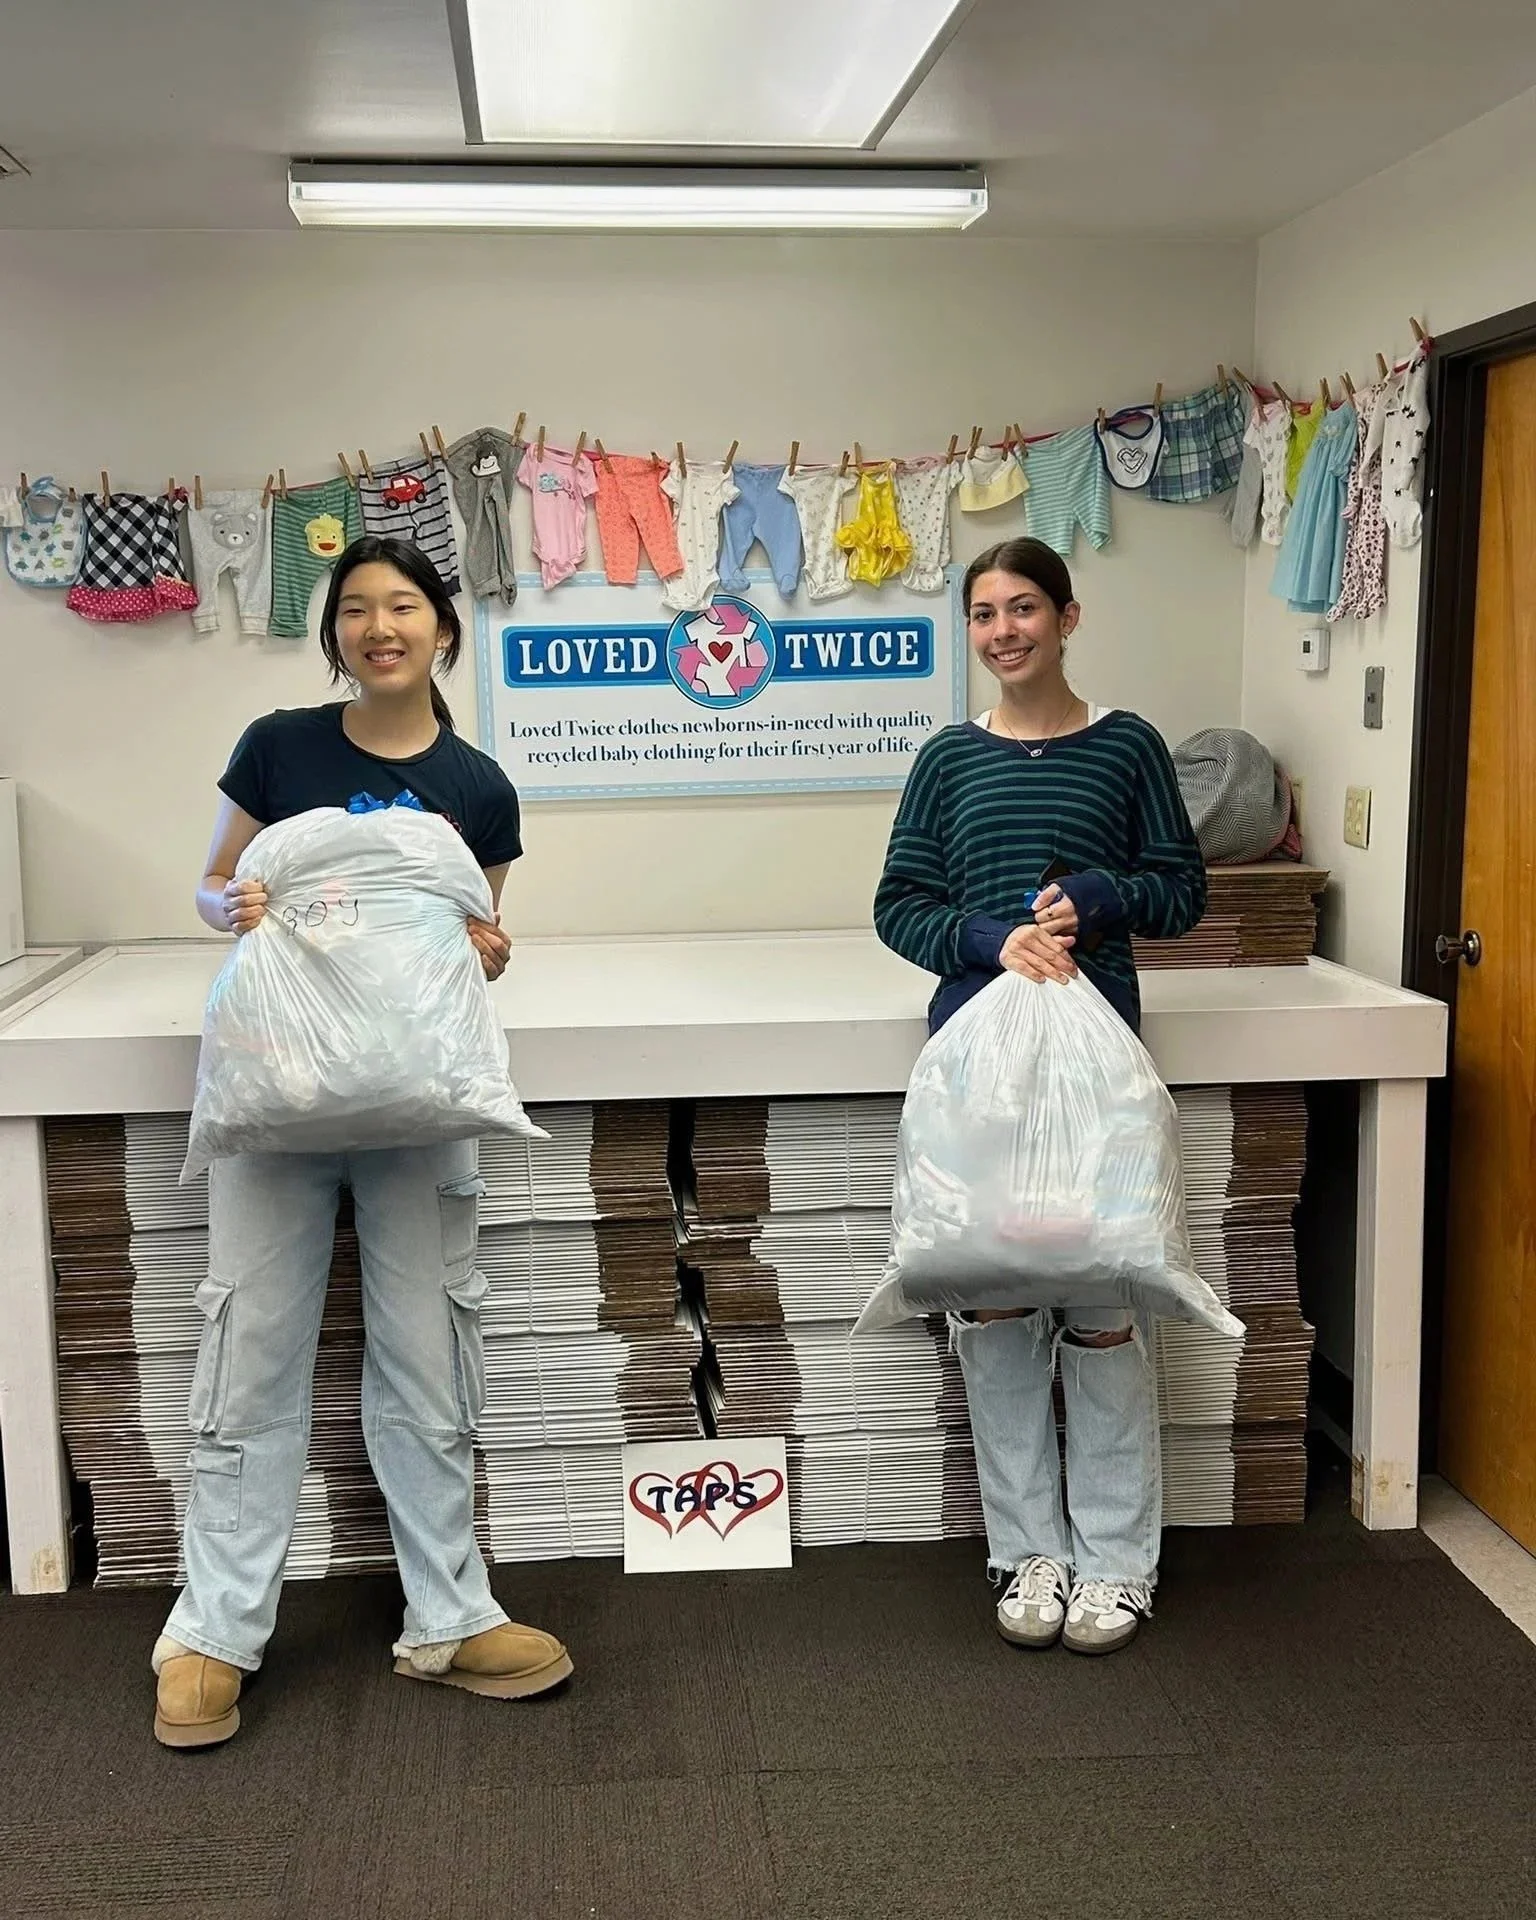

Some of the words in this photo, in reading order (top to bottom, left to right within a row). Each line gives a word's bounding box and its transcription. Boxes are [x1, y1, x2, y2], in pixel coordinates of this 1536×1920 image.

[518, 638, 657, 675] LOVED
[785, 630, 919, 668] TWICE
[510, 721, 561, 738] Loved
[565, 719, 614, 736] Twice
[618, 718, 679, 735] clothes
[682, 713, 833, 732] newborns-in-need
[837, 713, 872, 728] with
[877, 710, 934, 732] quality
[528, 746, 597, 767] recycled
[601, 745, 639, 765] baby
[644, 743, 716, 764] clothing
[718, 741, 743, 758] for
[747, 740, 788, 757] their
[792, 739, 825, 755] first
[826, 743, 863, 759] year
[867, 737, 883, 753] of
[884, 736, 918, 752] life.
[647, 1482, 757, 1513] TAPS
